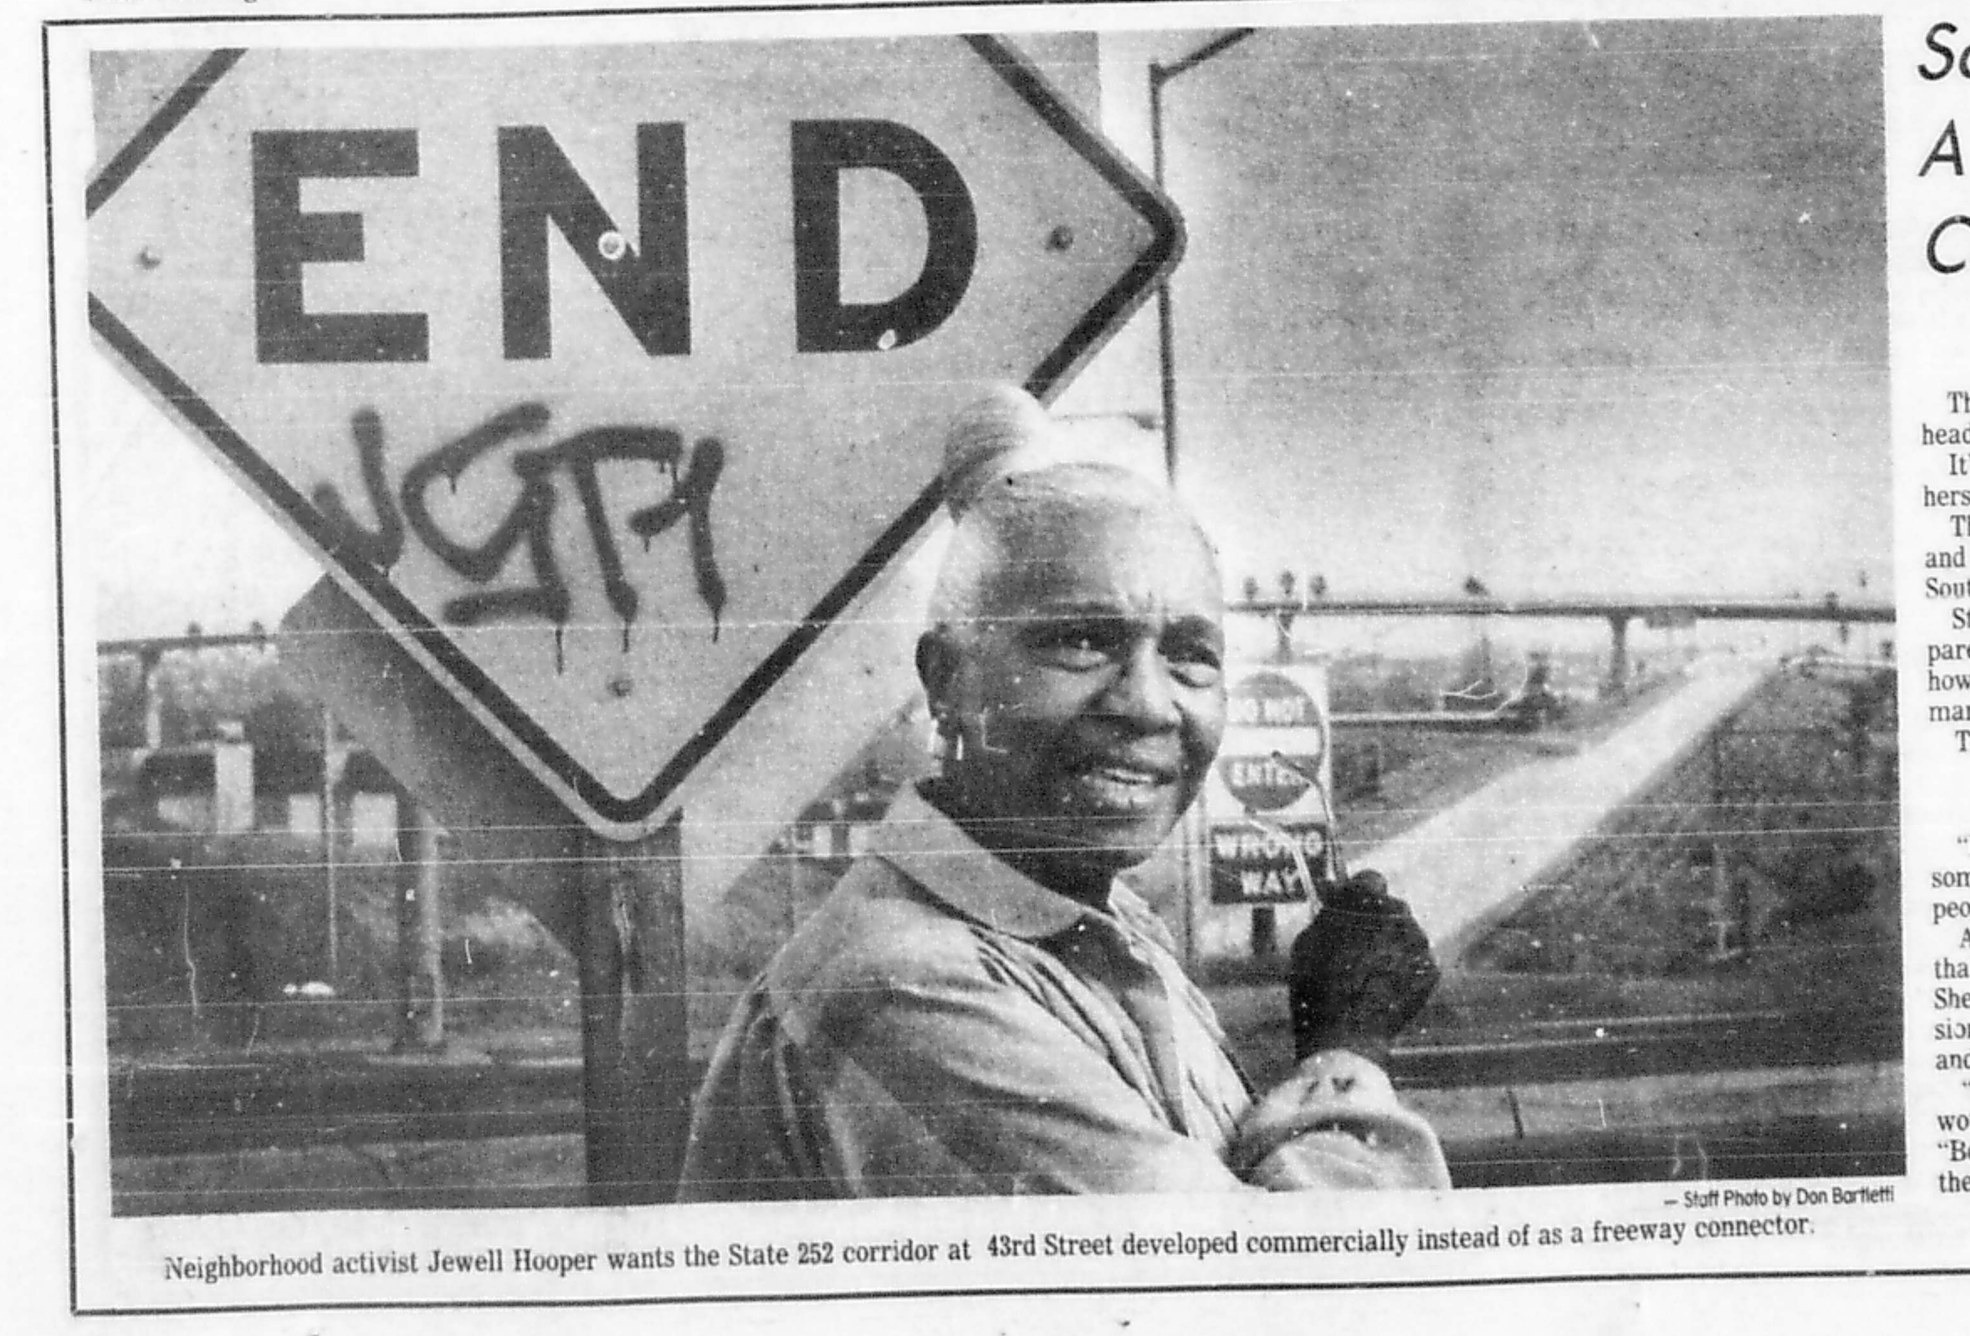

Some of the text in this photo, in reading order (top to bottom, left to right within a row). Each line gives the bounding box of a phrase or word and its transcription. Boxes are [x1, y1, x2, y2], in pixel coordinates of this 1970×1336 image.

[1918, 118, 1964, 177] A
[252, 119, 978, 363] END
[1926, 545, 1966, 568] and
[1240, 867, 1300, 896] WAY
[1684, 1190, 1720, 1209] Staff
[1724, 1189, 1769, 1207] Photo
[1773, 1188, 1792, 1207] by
[1796, 1187, 1828, 1206] Don
[1832, 1185, 1895, 1205] Bartletti
[166, 1215, 1815, 1284] Neighborhood activist Jewell Hooper wants the State 252 corridor at 43rd Street developed commercially instead of as a freeway connector.
